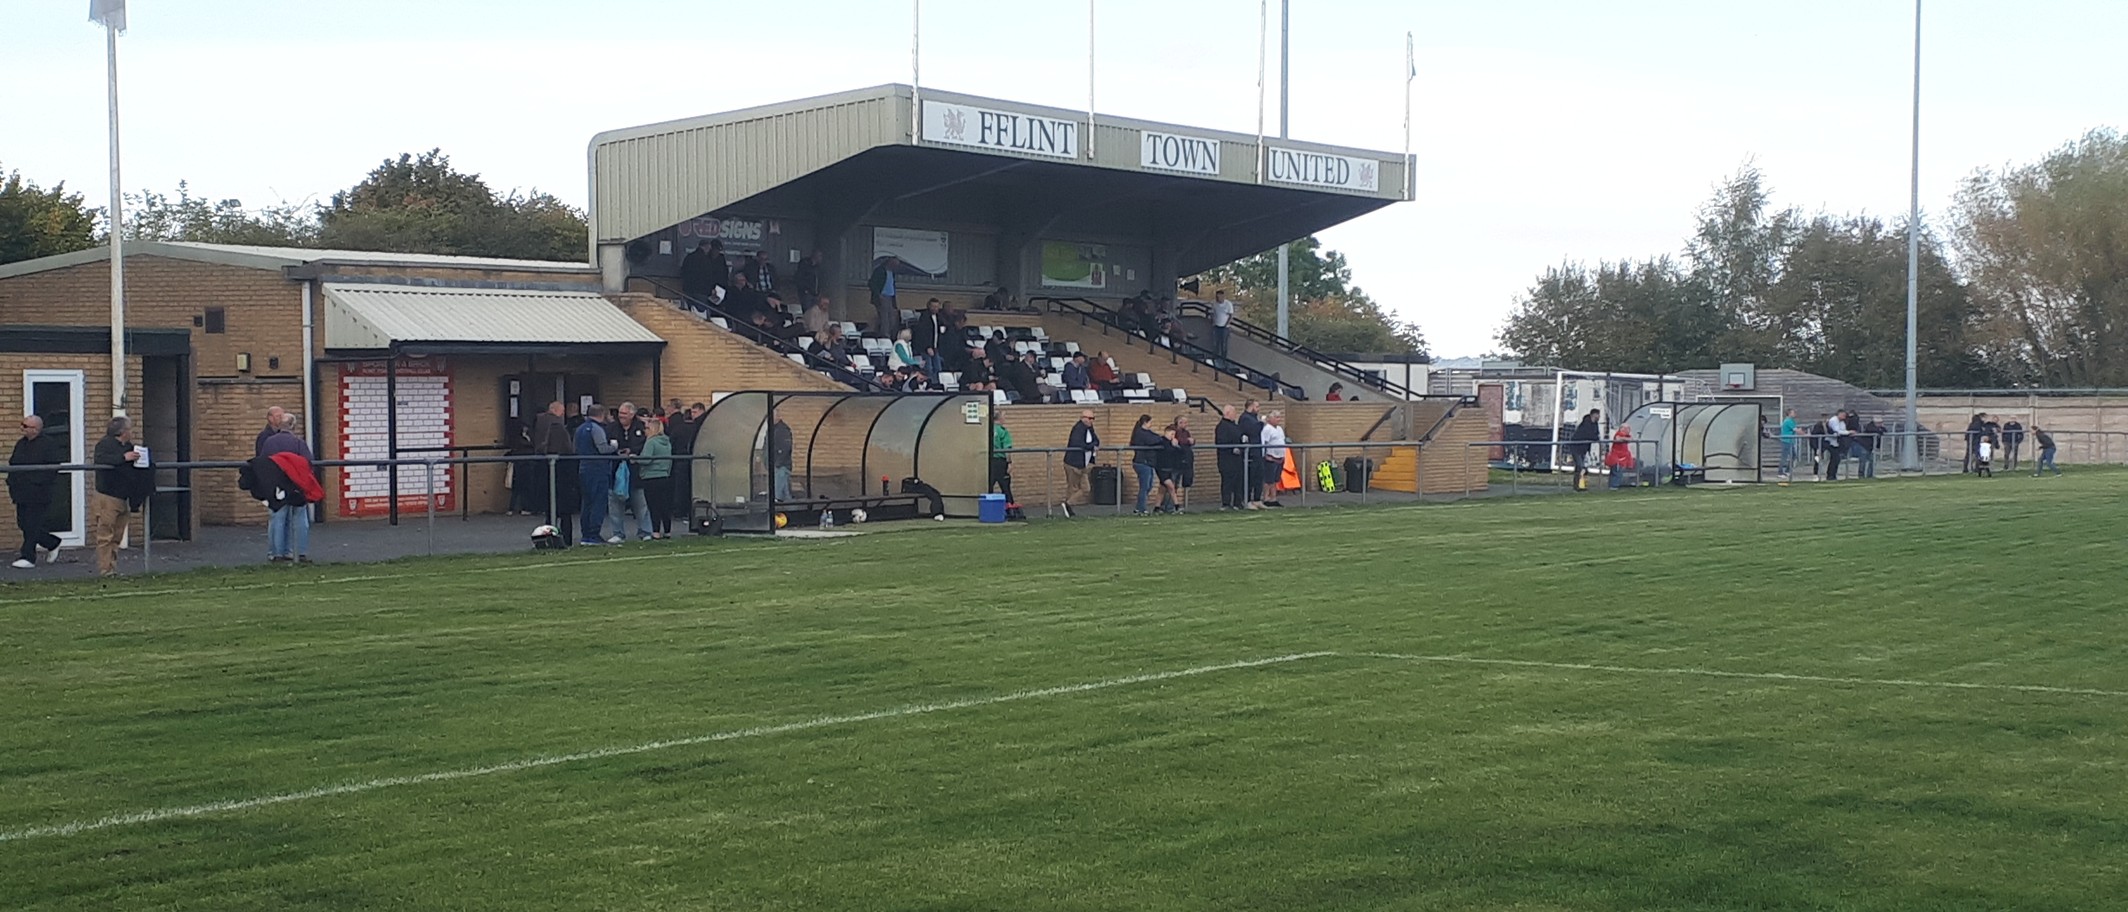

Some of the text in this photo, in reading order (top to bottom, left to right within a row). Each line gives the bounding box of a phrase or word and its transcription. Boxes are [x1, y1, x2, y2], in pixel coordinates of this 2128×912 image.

[978, 110, 1350, 185] FFLINT TOWN UNITED
[720, 219, 762, 240] SIGNS
